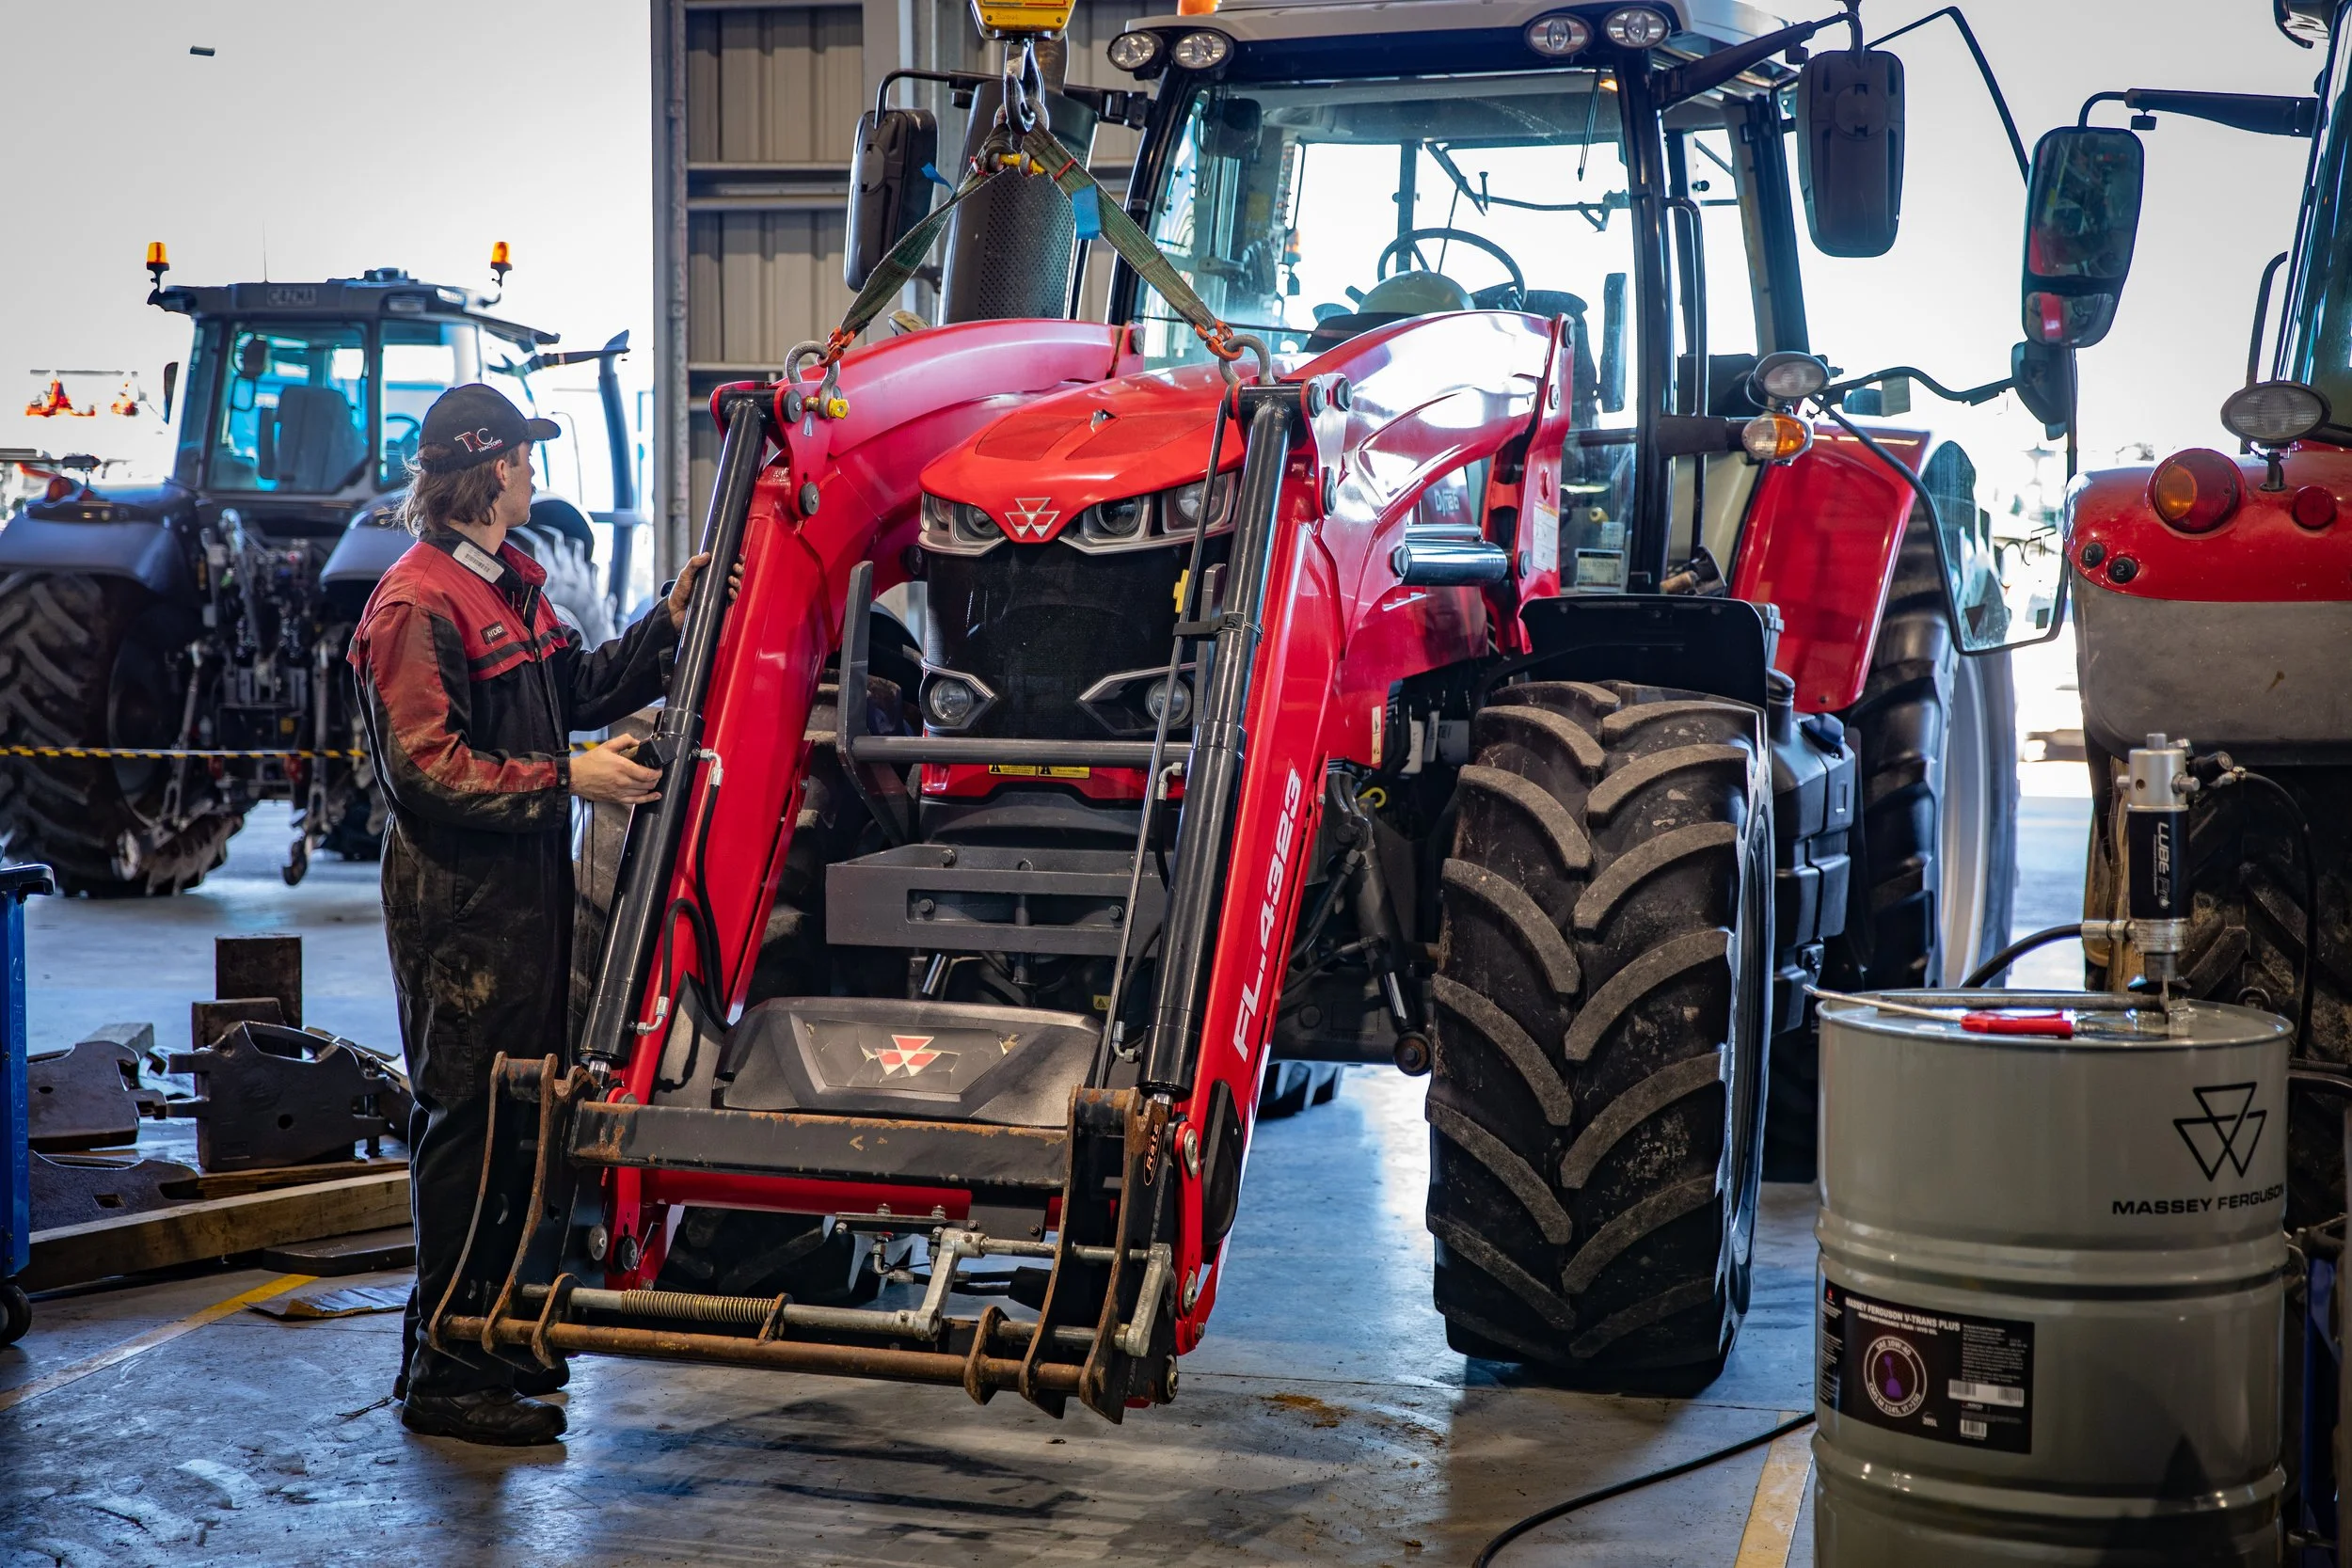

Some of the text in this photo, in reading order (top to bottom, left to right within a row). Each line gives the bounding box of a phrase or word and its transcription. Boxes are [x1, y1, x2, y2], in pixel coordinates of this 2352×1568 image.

[454, 428, 493, 451] TRC
[478, 439, 502, 452] TRACTORS
[2157, 821, 2171, 910] LUBE Pro
[1233, 768, 1302, 1063] FL.4323
[2112, 1181, 2285, 1214] MASSEY FERGUSON
[1844, 1296, 1867, 1312] MASSEY
[1867, 1305, 1903, 1322] FERGUSON
[1904, 1313, 1938, 1328] V-TRANS
[1938, 1319, 1961, 1331] PLUS
[1875, 1339, 1887, 1352] SAE
[1922, 1417, 1938, 1428] 205L
